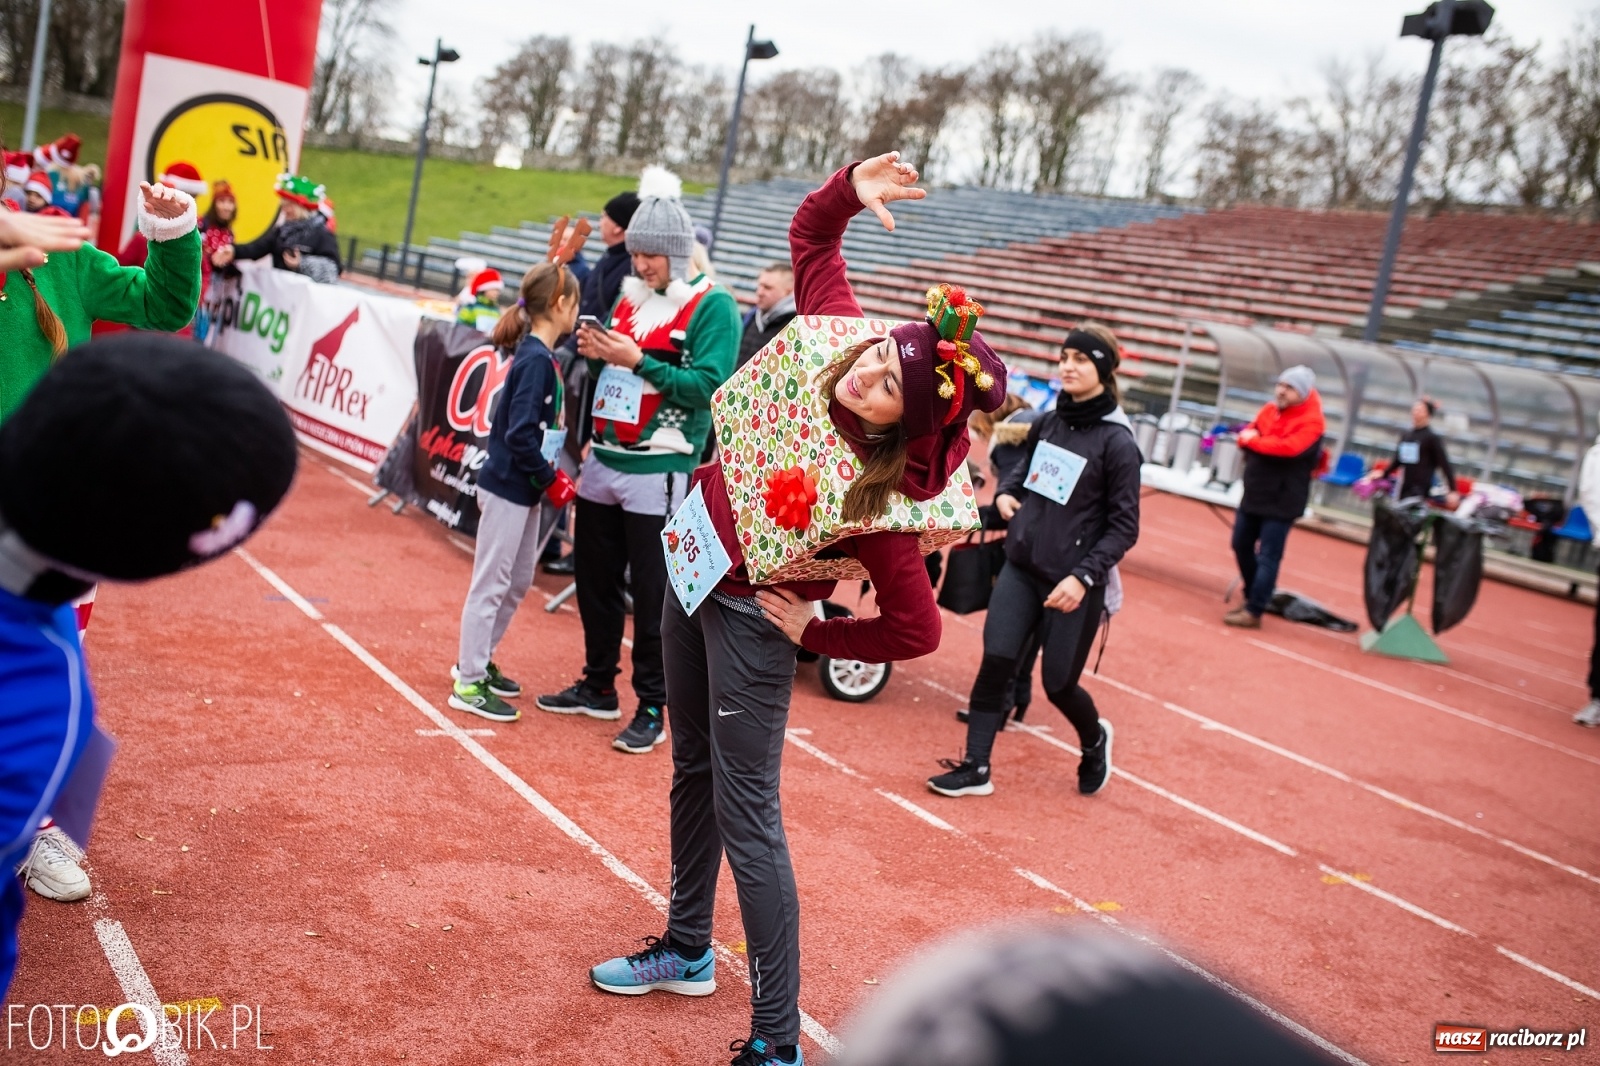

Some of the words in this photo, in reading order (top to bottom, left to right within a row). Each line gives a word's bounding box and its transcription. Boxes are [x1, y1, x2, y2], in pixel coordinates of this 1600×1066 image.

[303, 356, 373, 421] FIPRex
[604, 384, 622, 399] 002
[681, 528, 701, 563] 135
